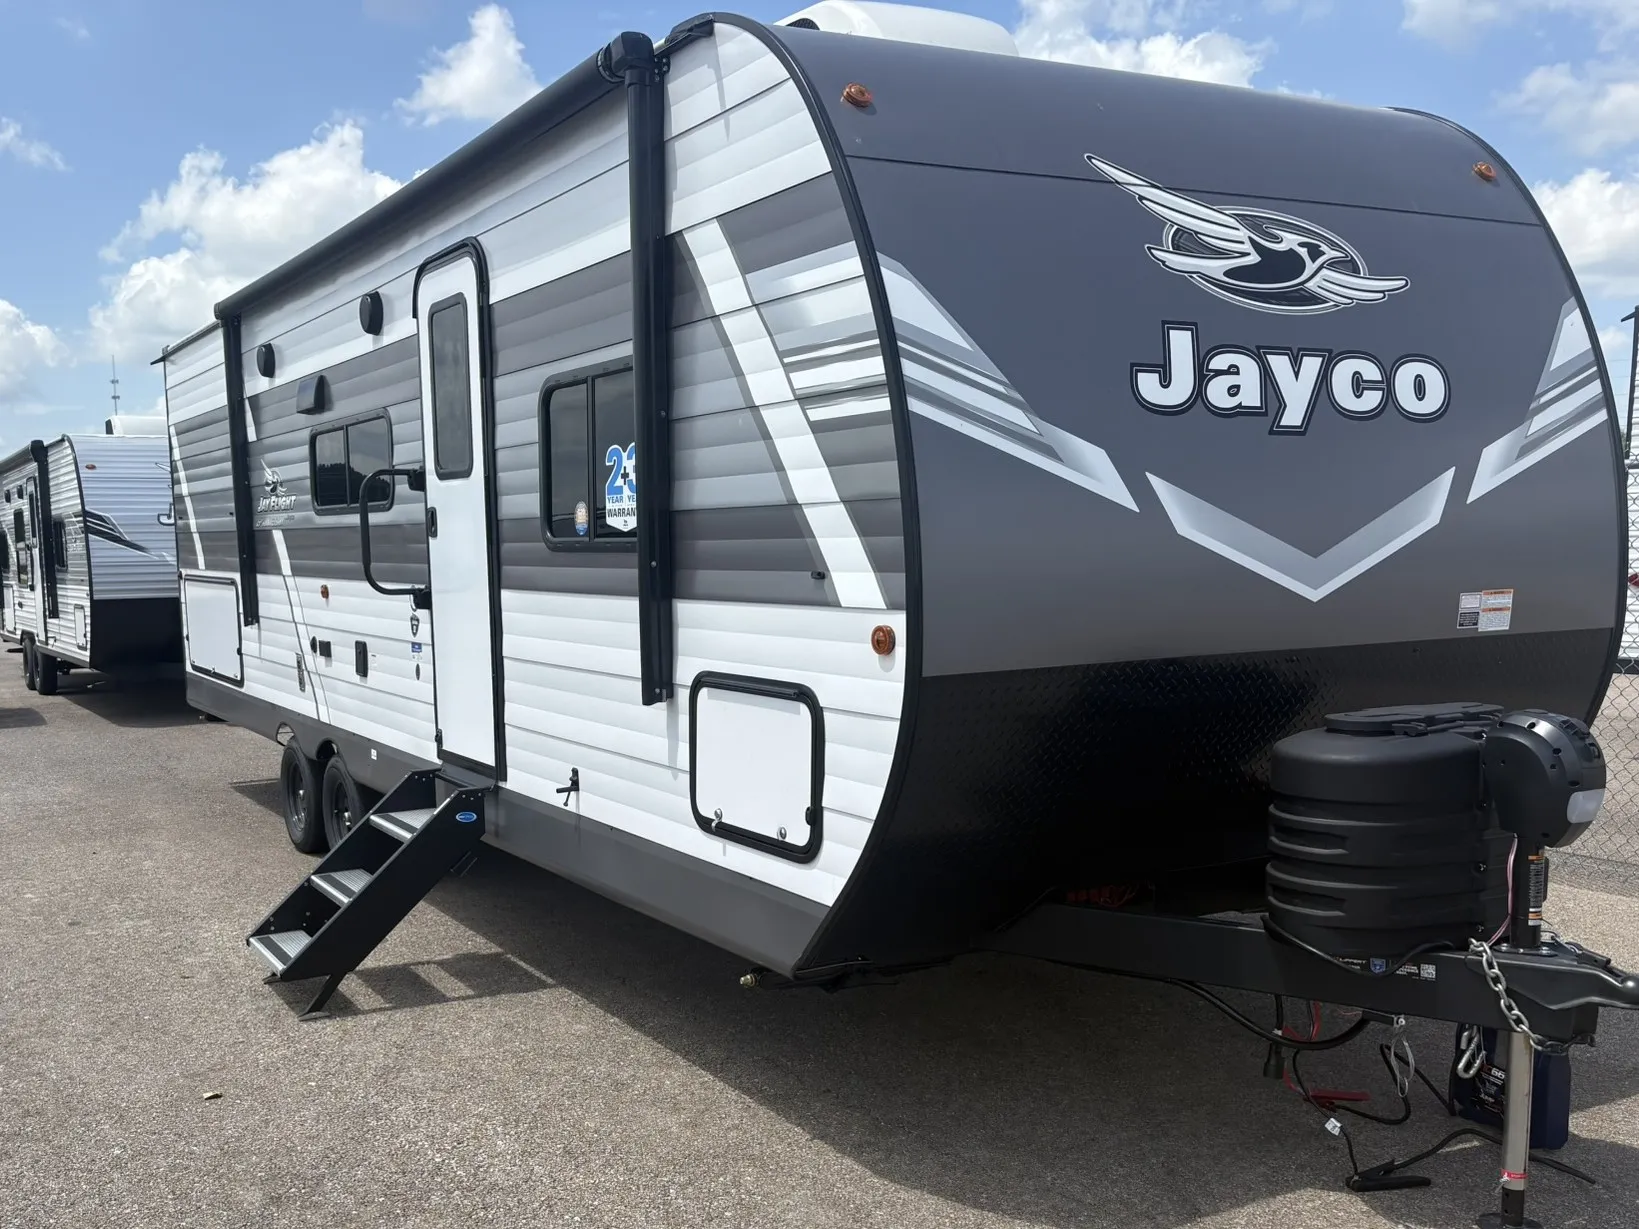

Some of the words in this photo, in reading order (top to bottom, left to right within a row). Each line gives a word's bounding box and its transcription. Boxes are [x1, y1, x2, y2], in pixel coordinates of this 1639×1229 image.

[1131, 320, 1450, 435] Jayco
[607, 496, 624, 504] YEAR
[627, 495, 636, 503] YE
[607, 507, 636, 518] WARRAN
